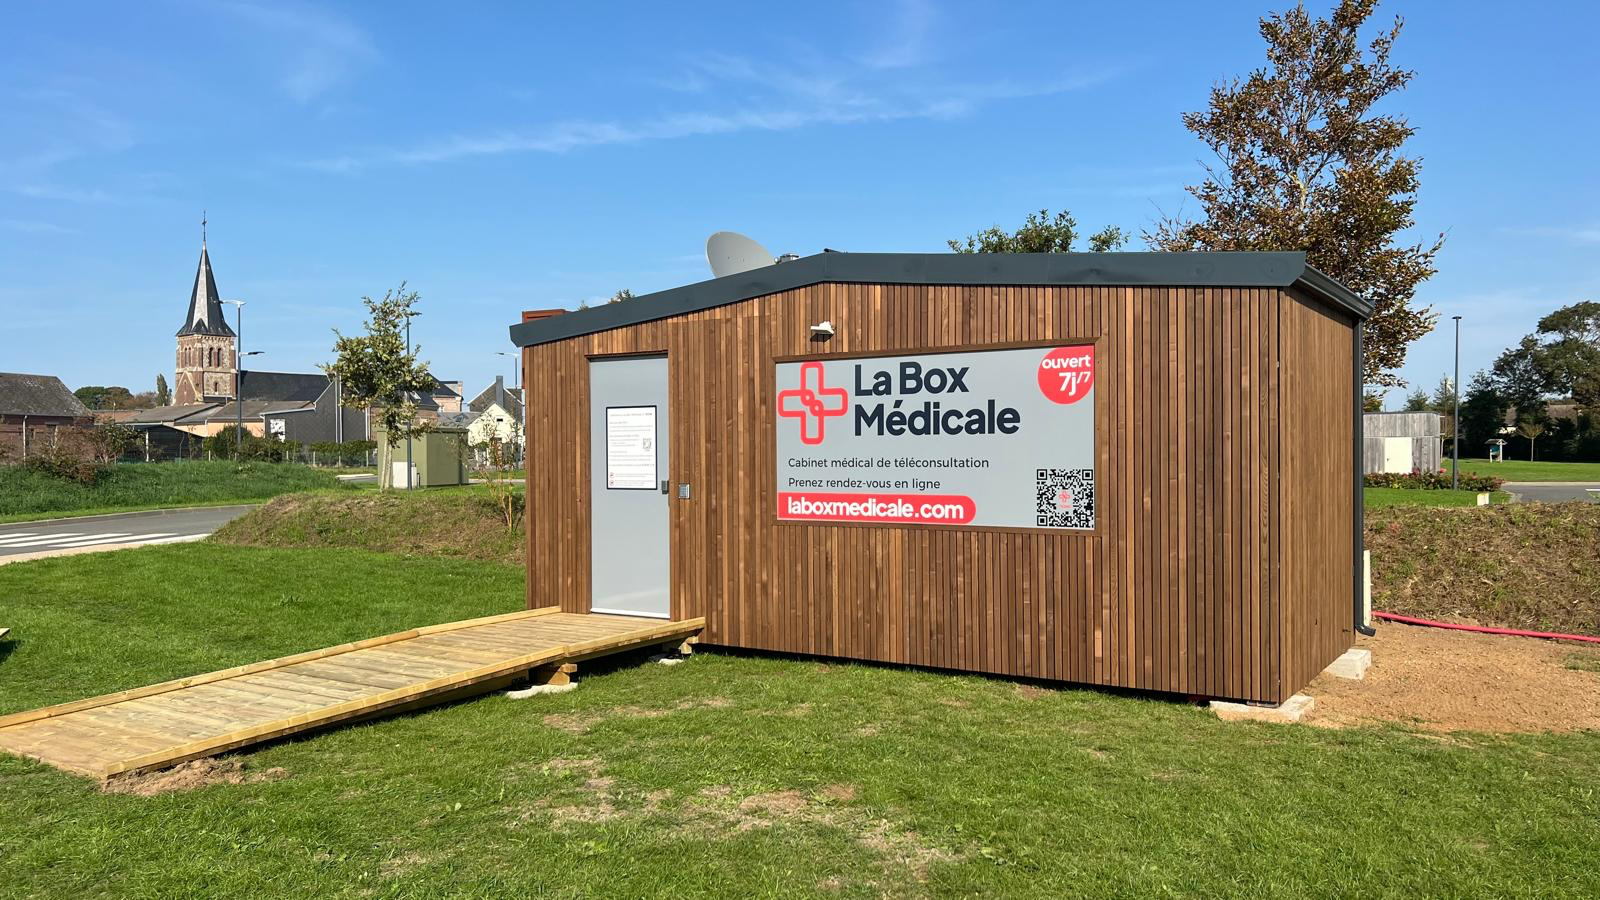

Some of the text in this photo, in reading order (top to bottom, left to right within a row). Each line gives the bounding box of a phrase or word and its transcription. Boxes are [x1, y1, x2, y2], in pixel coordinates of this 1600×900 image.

[1042, 354, 1091, 369] ouvert
[854, 361, 970, 397] La Box
[854, 399, 1021, 436] Médicale
[788, 457, 990, 468] Cabinet médical de téléconsultation
[788, 478, 941, 491] Prenez rendez-vous en ligne
[787, 496, 964, 519] laboxmedicale.com
